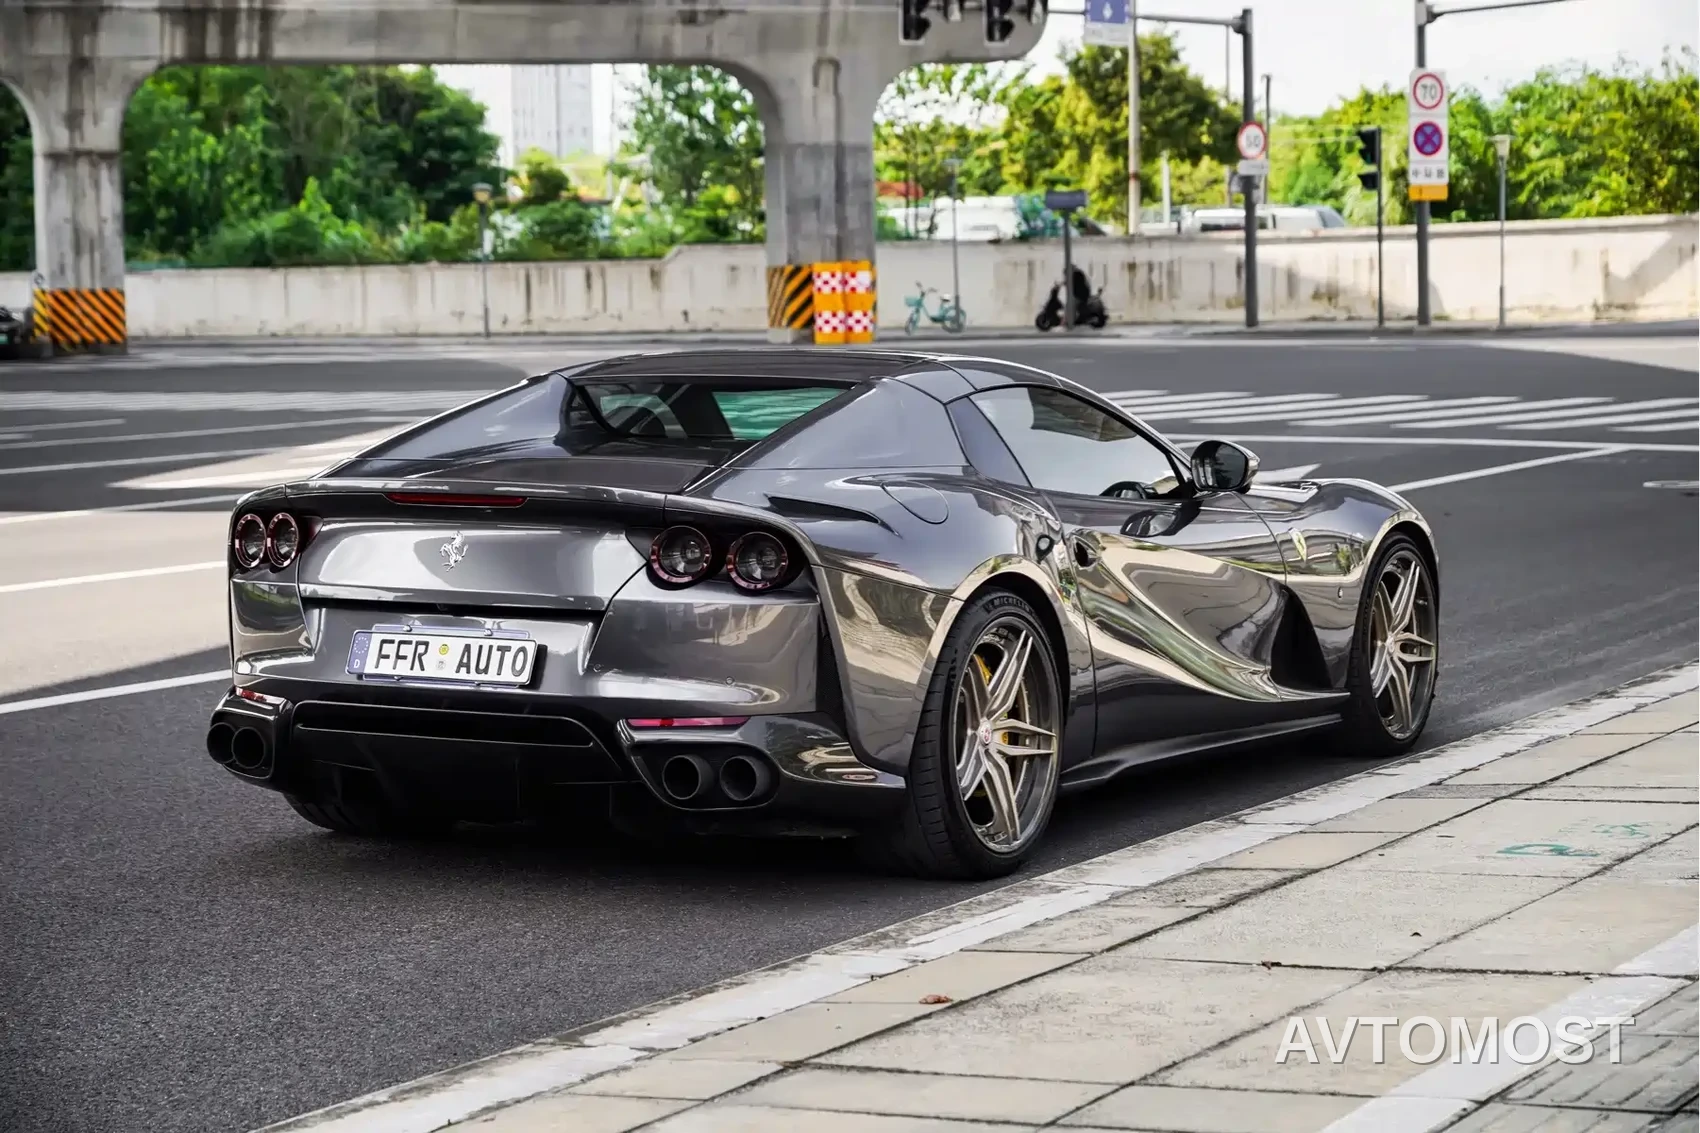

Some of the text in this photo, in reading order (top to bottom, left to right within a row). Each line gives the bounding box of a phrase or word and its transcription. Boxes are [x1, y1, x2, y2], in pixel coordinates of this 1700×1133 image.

[1420, 83, 1438, 101] 70
[353, 658, 361, 669] D
[374, 638, 529, 678] FFR AUTO
